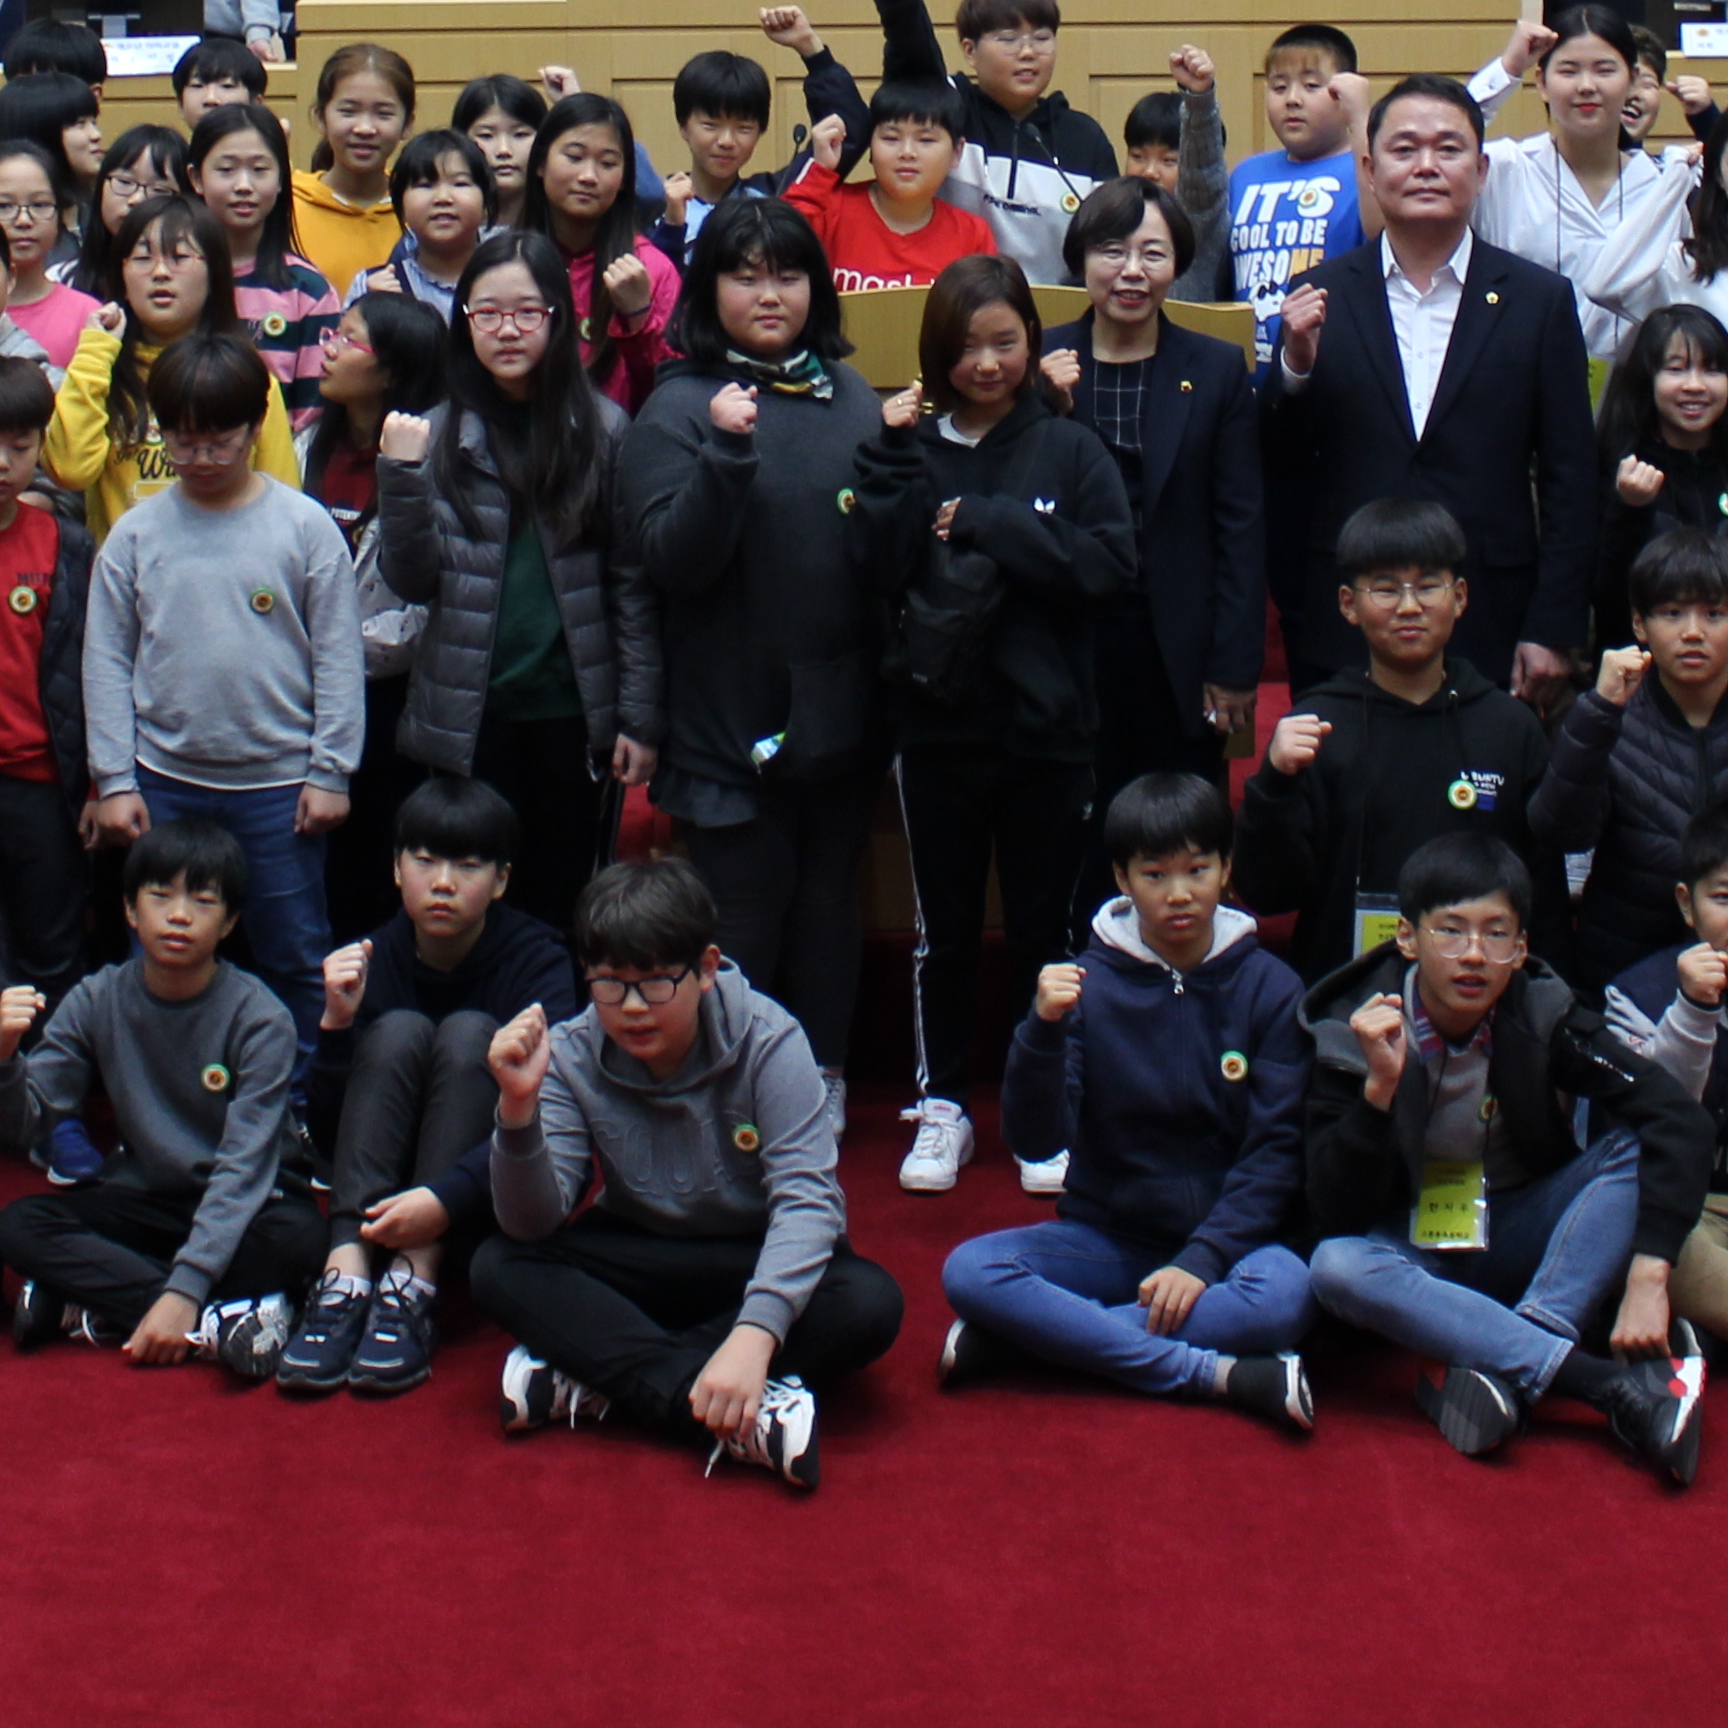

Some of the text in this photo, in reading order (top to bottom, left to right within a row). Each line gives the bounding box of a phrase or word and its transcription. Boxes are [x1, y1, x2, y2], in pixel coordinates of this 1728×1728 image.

[1230, 218, 1329, 253] COOL TO BE
[1234, 247, 1325, 293] WESOME
